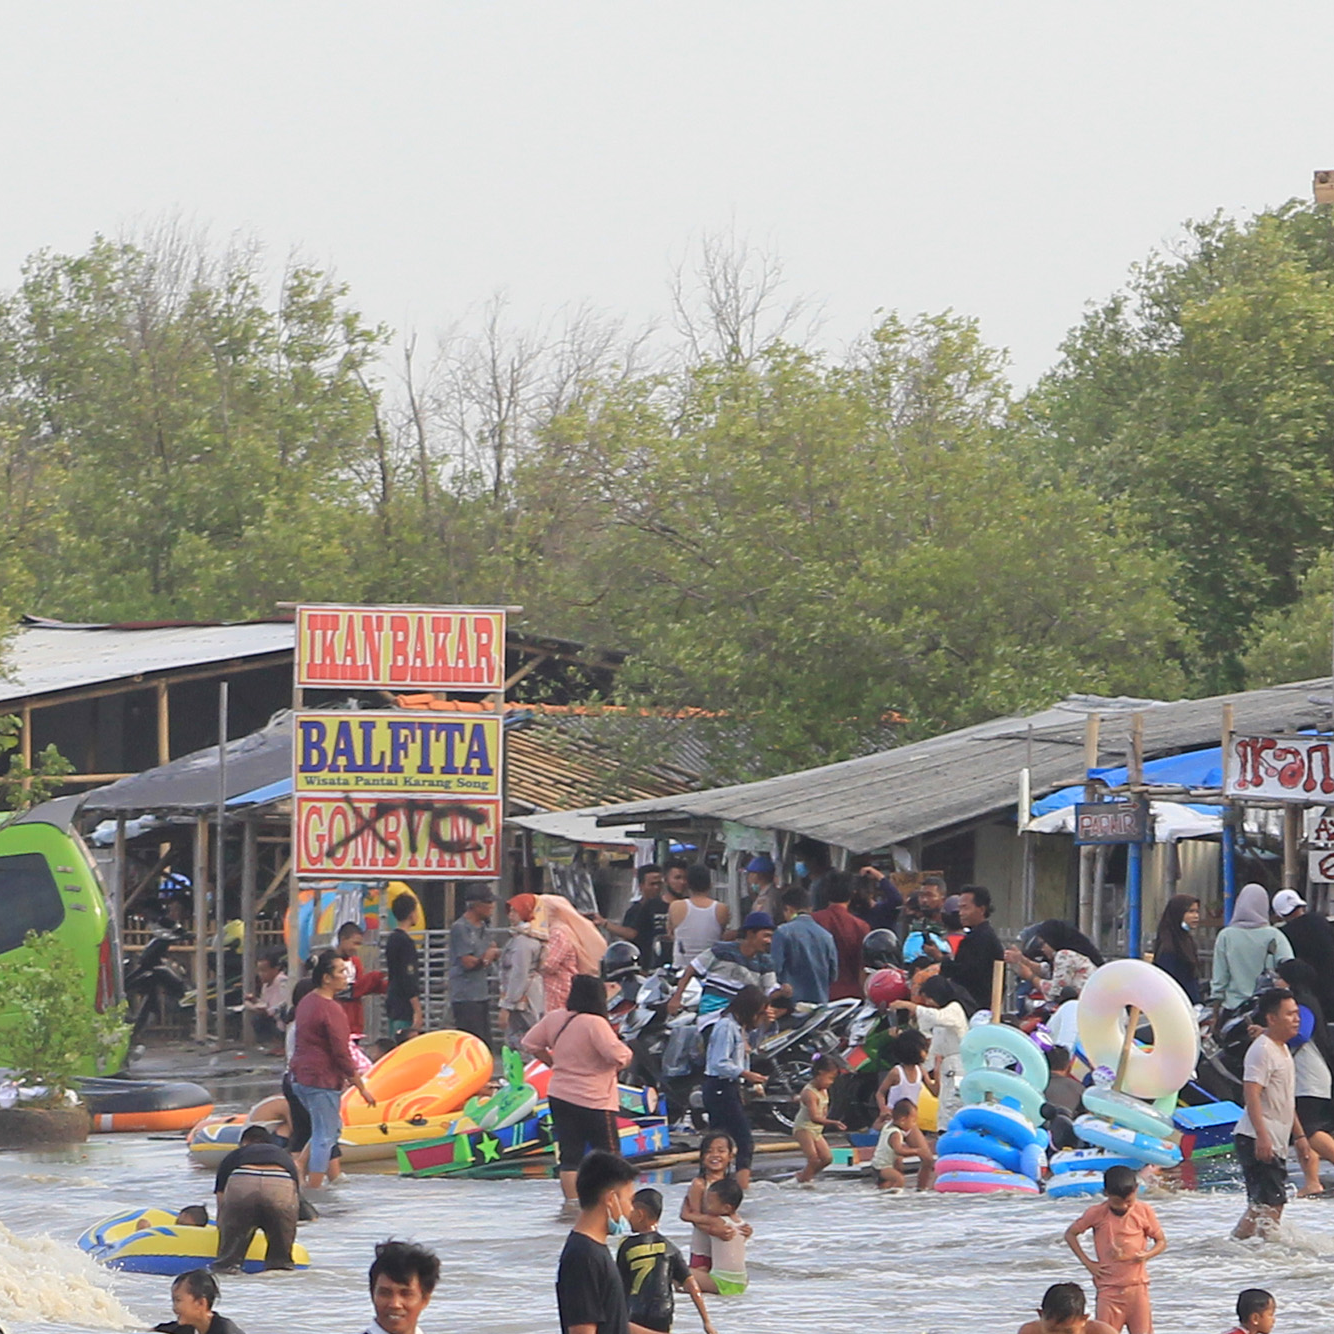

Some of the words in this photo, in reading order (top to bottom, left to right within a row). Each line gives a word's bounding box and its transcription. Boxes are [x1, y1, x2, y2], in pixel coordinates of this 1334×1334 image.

[307, 613, 384, 681] IKAN
[390, 616, 494, 683] BAKAR
[299, 720, 494, 776] BALFITA
[304, 775, 349, 786] Wisata
[354, 775, 398, 787] Pantai
[402, 776, 452, 790] Karang
[456, 778, 489, 791] Song
[630, 1257, 656, 1295] 7
